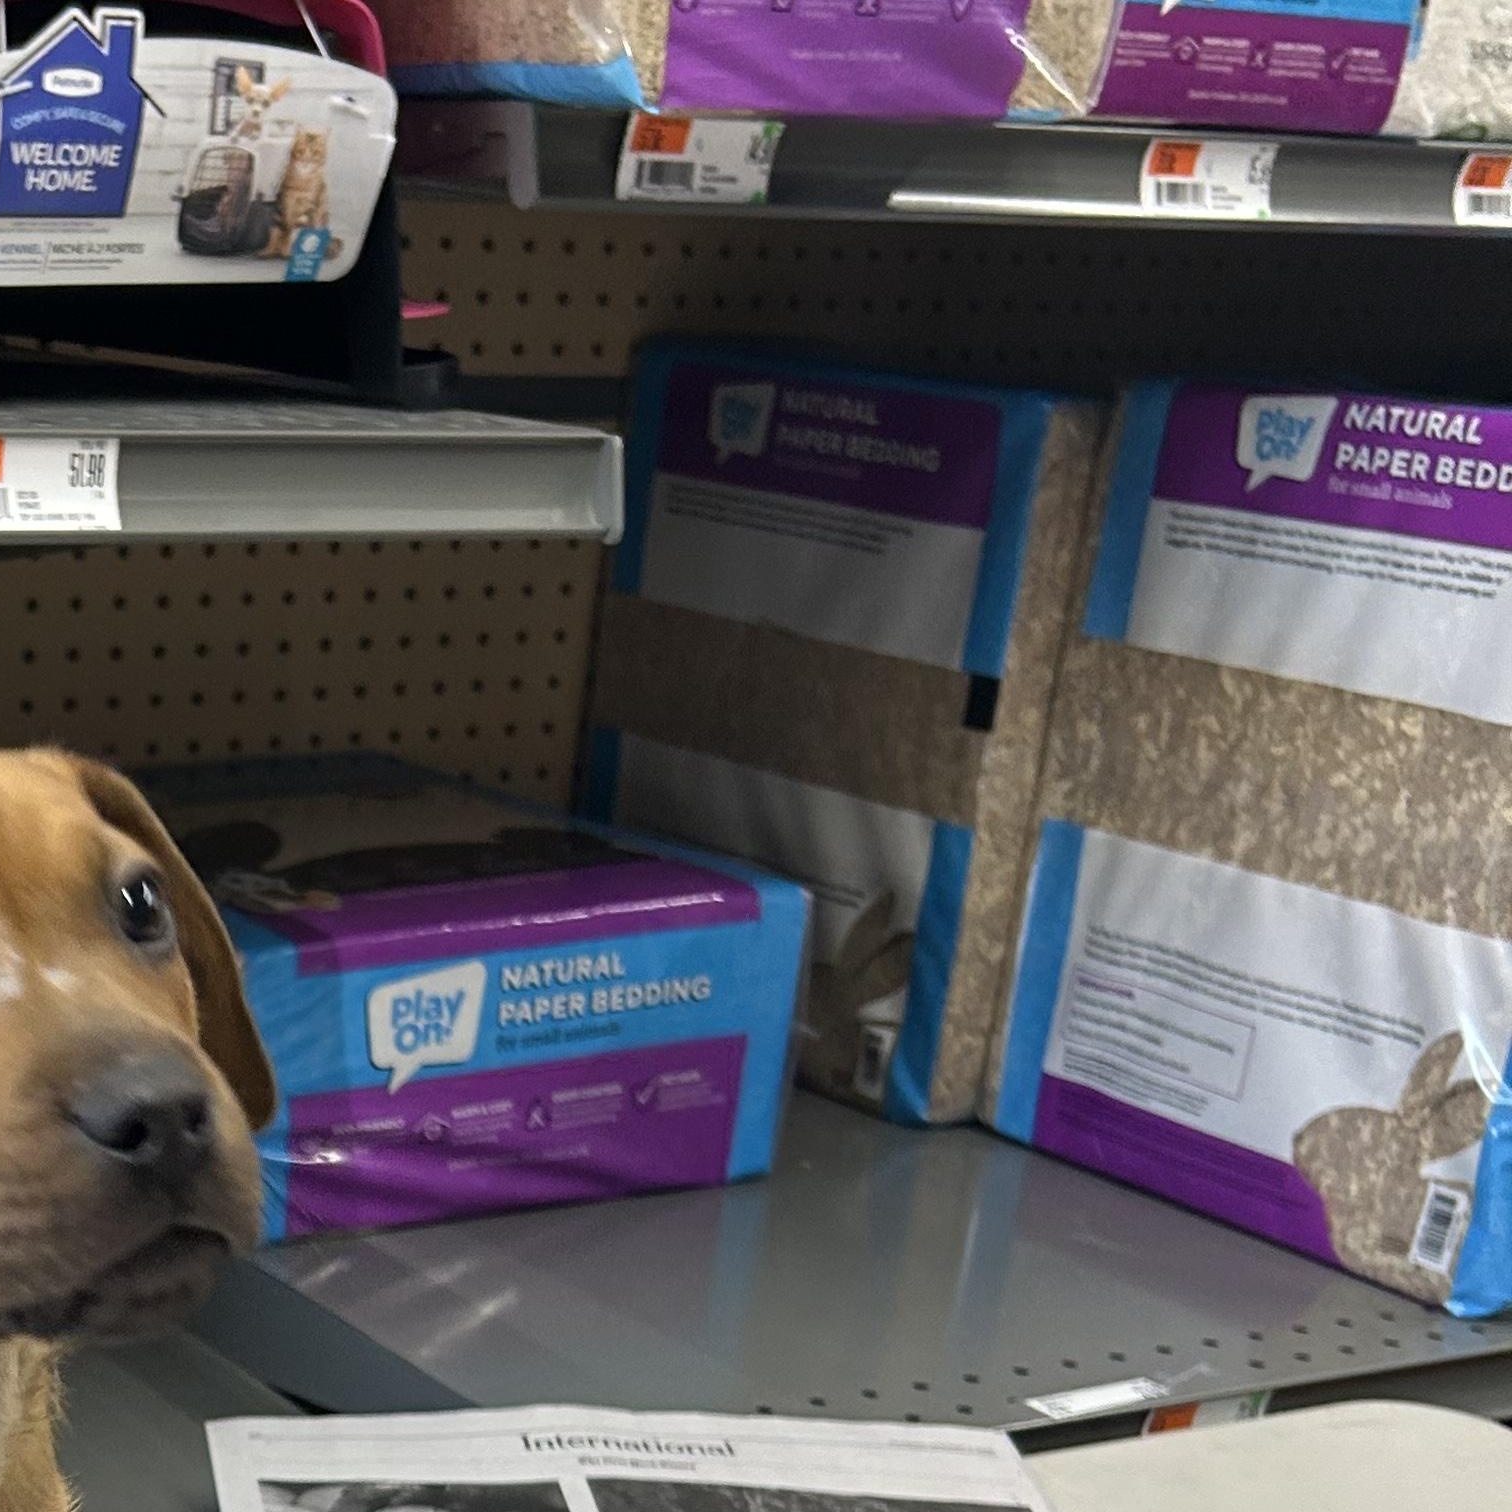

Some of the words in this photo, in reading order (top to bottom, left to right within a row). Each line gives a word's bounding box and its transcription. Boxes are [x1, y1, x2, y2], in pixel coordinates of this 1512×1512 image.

[9, 141, 123, 168] WELCOME
[1344, 402, 1485, 446] NATURAL
[69, 453, 105, 488] 51.98
[1334, 441, 1431, 482] PAPER
[500, 950, 626, 992] NATURAL
[498, 992, 586, 1028] PAPER
[590, 974, 712, 1016] BEDDING
[521, 1432, 736, 1457] International
